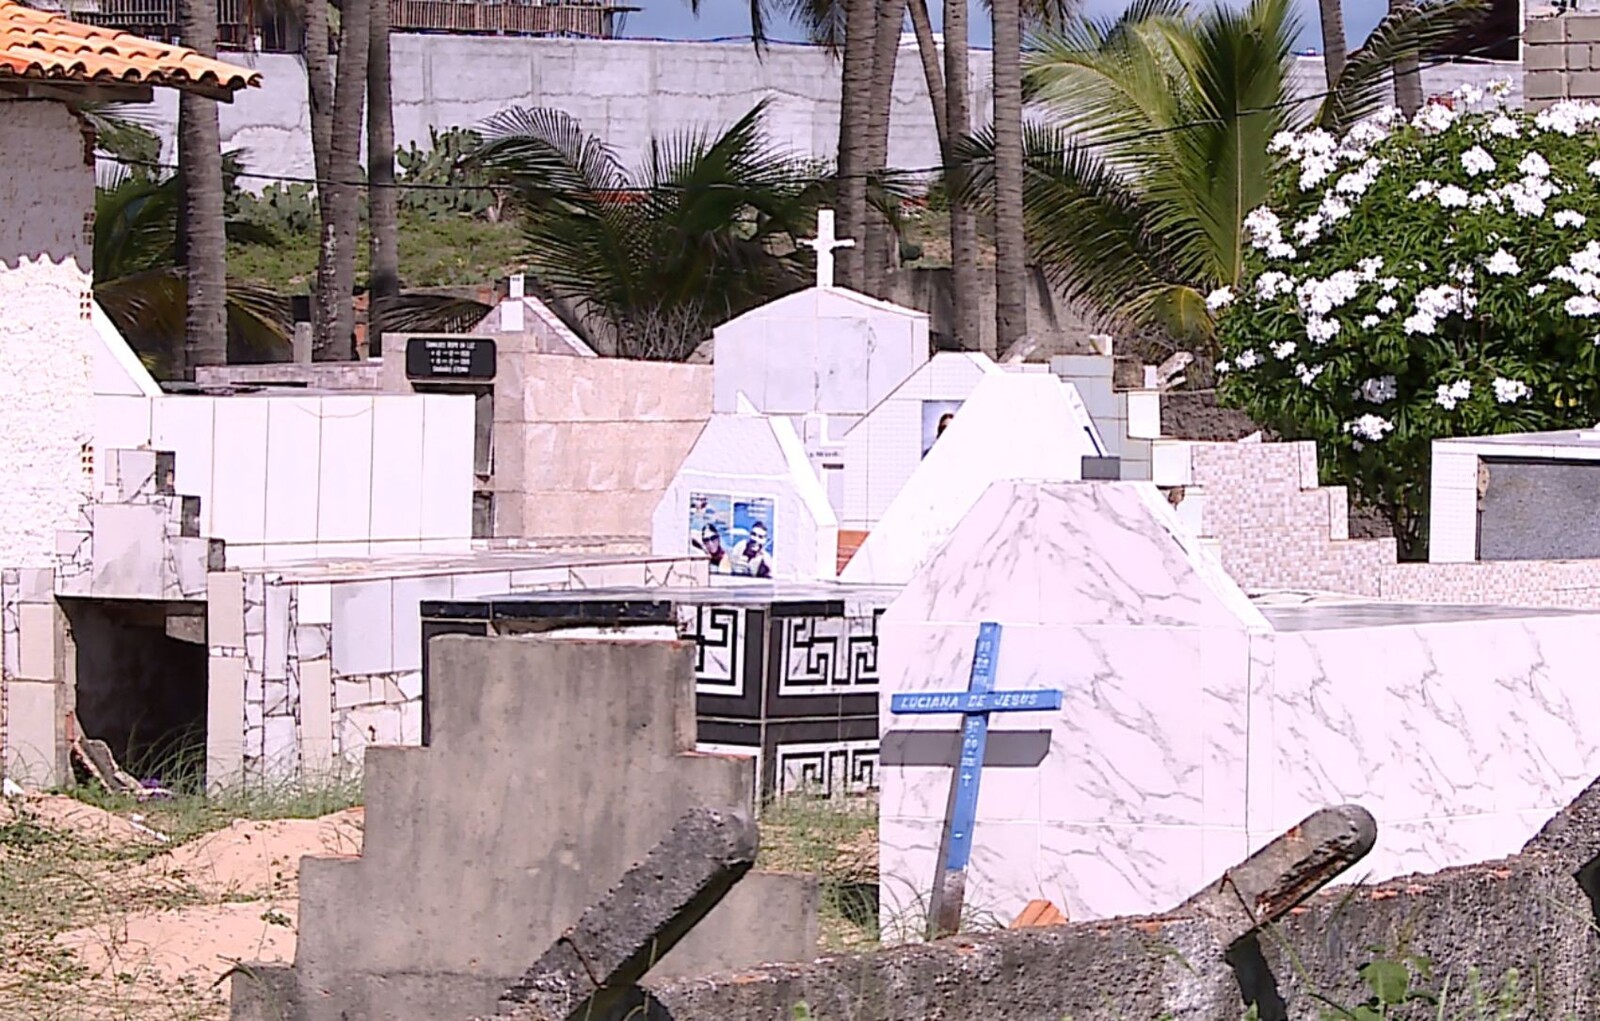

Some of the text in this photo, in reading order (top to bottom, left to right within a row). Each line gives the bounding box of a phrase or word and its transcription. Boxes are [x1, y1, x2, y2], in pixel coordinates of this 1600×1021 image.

[900, 693, 1039, 708] LUCIANA DE JESUS
